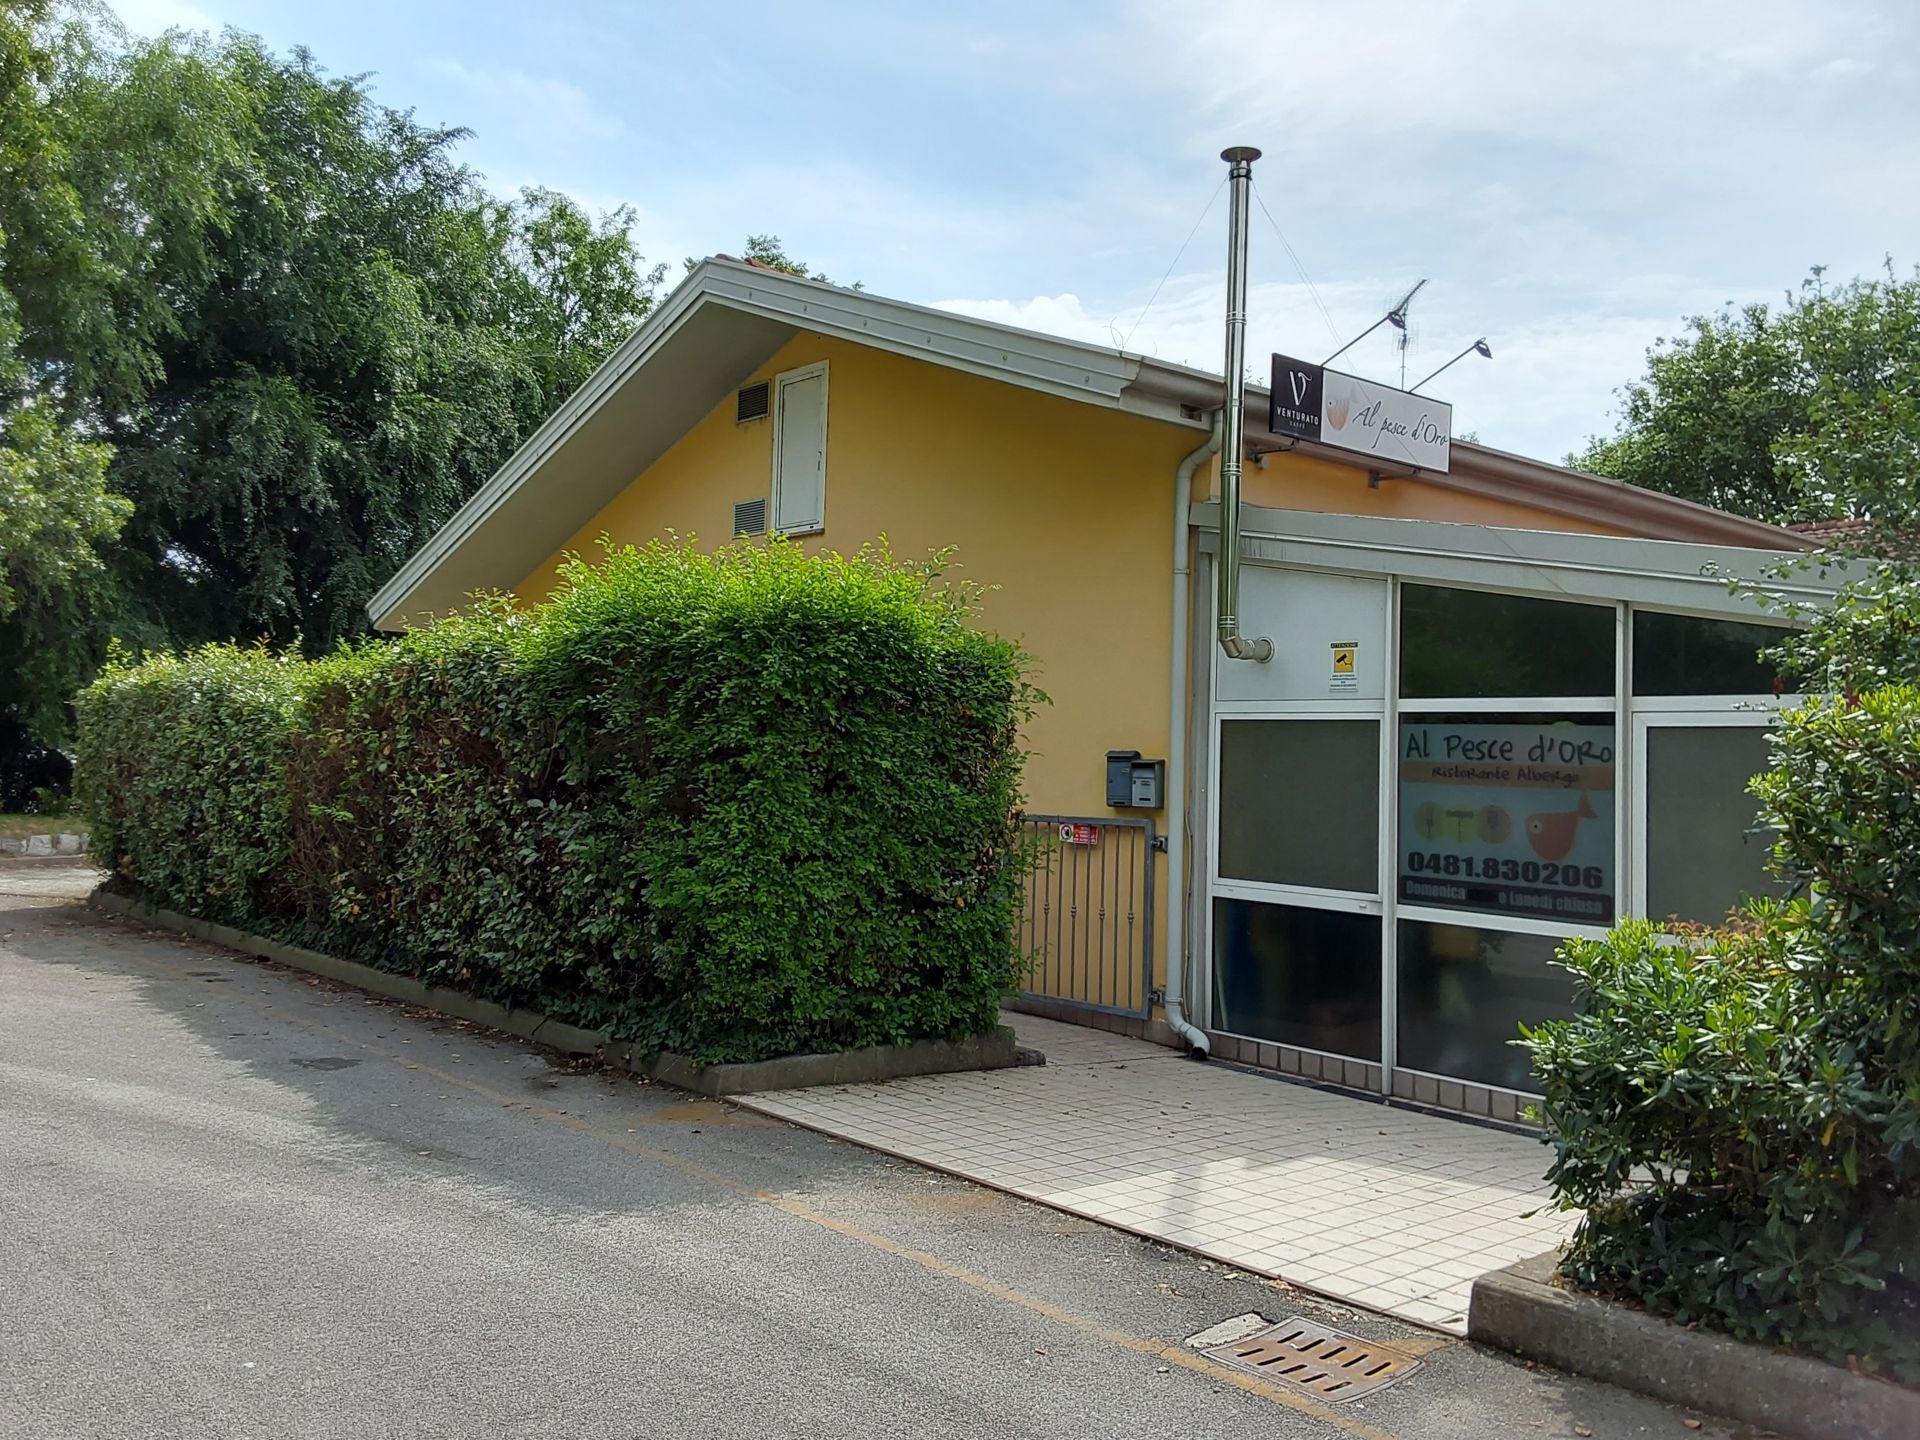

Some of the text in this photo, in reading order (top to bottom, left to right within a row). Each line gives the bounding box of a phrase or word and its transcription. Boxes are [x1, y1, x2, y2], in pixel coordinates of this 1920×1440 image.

[1276, 406, 1319, 425] VENTURATO
[1352, 401, 1448, 449] Al pesce d'Oro
[1405, 729, 1430, 759] Al
[1443, 734, 1513, 761] Pesce
[1407, 851, 1603, 889] 0481.830206
[1406, 880, 1466, 900] Domenica
[1556, 896, 1603, 915] chiuso
